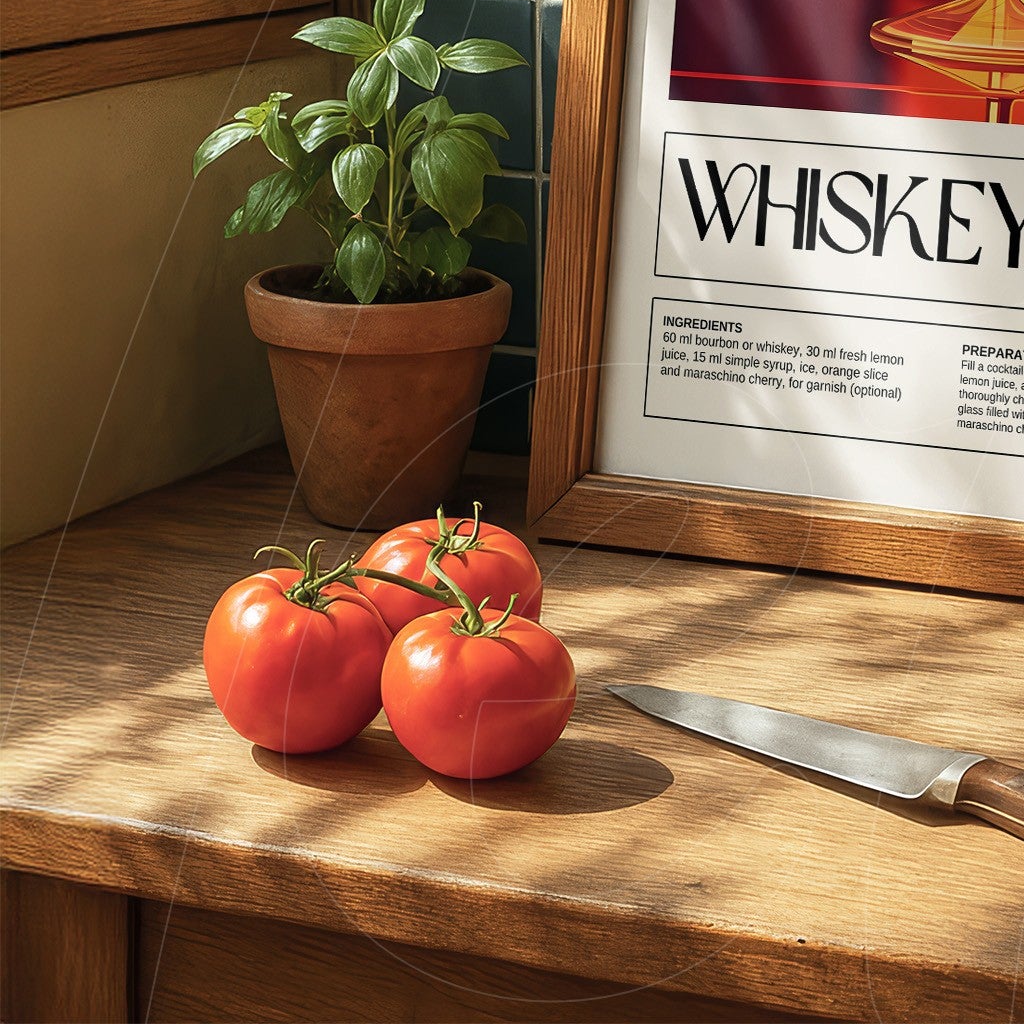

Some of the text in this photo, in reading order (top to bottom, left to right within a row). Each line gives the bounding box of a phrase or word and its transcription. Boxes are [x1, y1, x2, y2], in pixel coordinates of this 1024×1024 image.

[663, 315, 742, 333] INGREDIENTS
[663, 331, 904, 365] 60 ml bourbon or whiskey, 30 ml fresh lemon
[660, 347, 888, 381] juice, 15 ml simple syrup, ice, orange slice
[961, 359, 975, 371] Fill
[977, 363, 984, 372] a
[986, 363, 1023, 375] cocktail
[660, 365, 901, 402] and maraschino cherry, for garnish (optional)
[960, 374, 989, 386] lemon
[991, 377, 1017, 391] juice,
[959, 388, 1011, 405] thoroughly
[957, 403, 983, 416] glass
[986, 406, 1009, 418] filled
[957, 419, 1013, 433] maraschino
